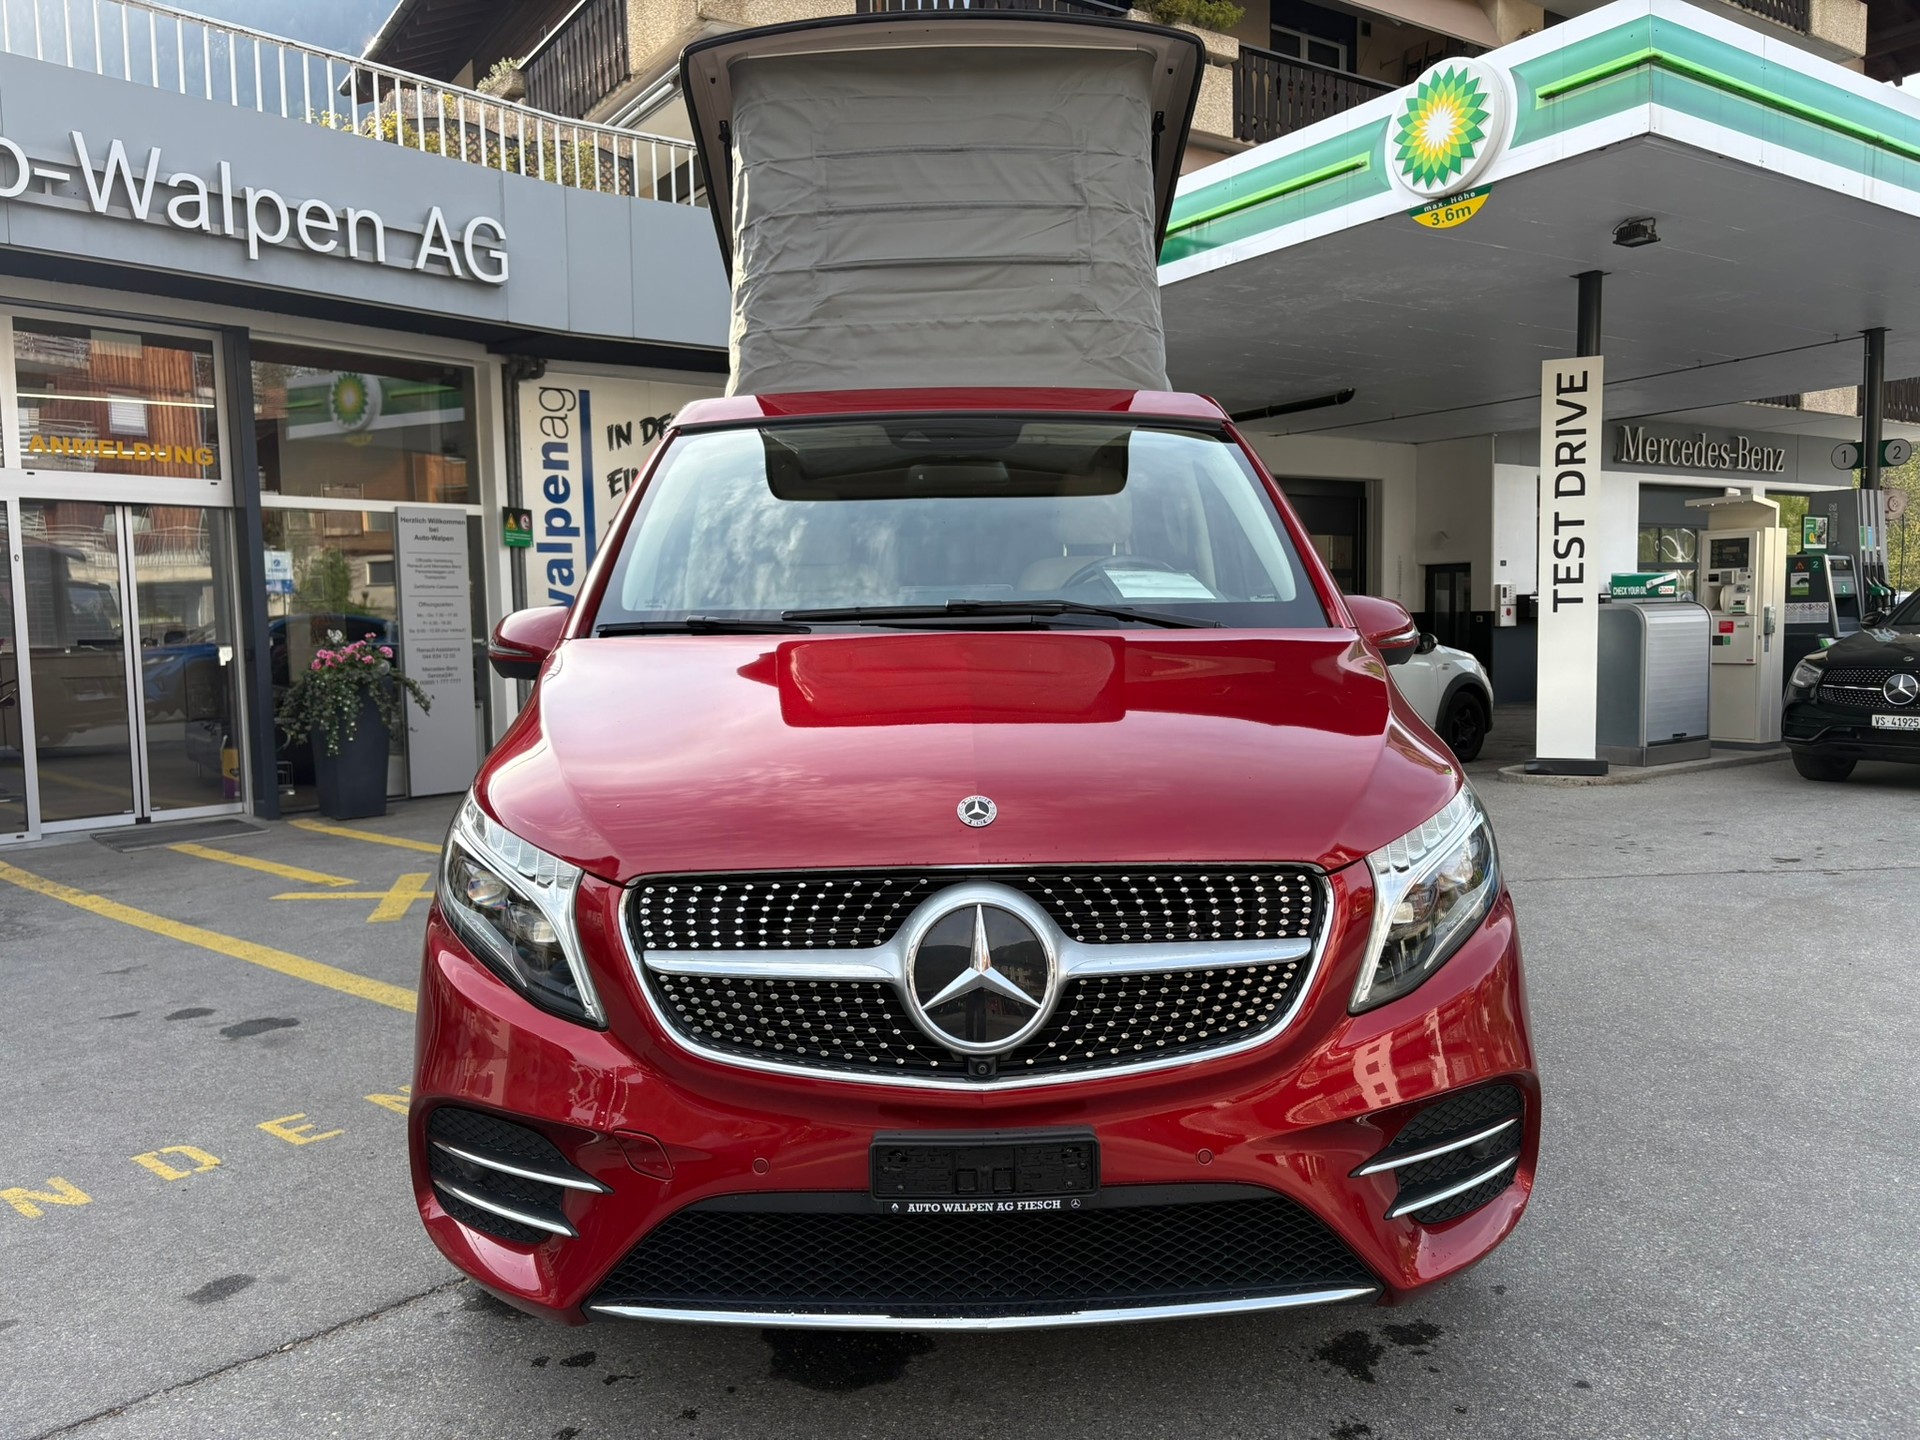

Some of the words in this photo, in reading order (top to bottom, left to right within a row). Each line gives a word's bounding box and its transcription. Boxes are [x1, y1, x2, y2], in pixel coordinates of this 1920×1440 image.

[1424, 201, 1447, 212] max.
[1450, 191, 1476, 204] Höhe
[1430, 206, 1472, 226] 3.6m
[416, 206, 509, 283] AG
[606, 421, 633, 452] IN
[1554, 370, 1588, 499] DRIVE
[28, 434, 215, 467] ANMELDUNG
[1621, 425, 1785, 473] Mercedes-Benz
[1840, 449, 1848, 464] 1
[1893, 445, 1902, 460] 2
[400, 516, 426, 524] Herzlich
[428, 517, 466, 526] Willkommen
[414, 534, 454, 542] Auto-Walpen
[1553, 511, 1585, 613] TEST
[1811, 561, 1819, 569] 2
[1612, 586, 1627, 596] CHECK
[1628, 585, 1640, 595] YOUR
[907, 1203, 941, 1213] AUTO
[942, 1202, 994, 1212] WALPEN
[996, 1202, 1014, 1211] AG
[1016, 1200, 1061, 1211] FIESCH
